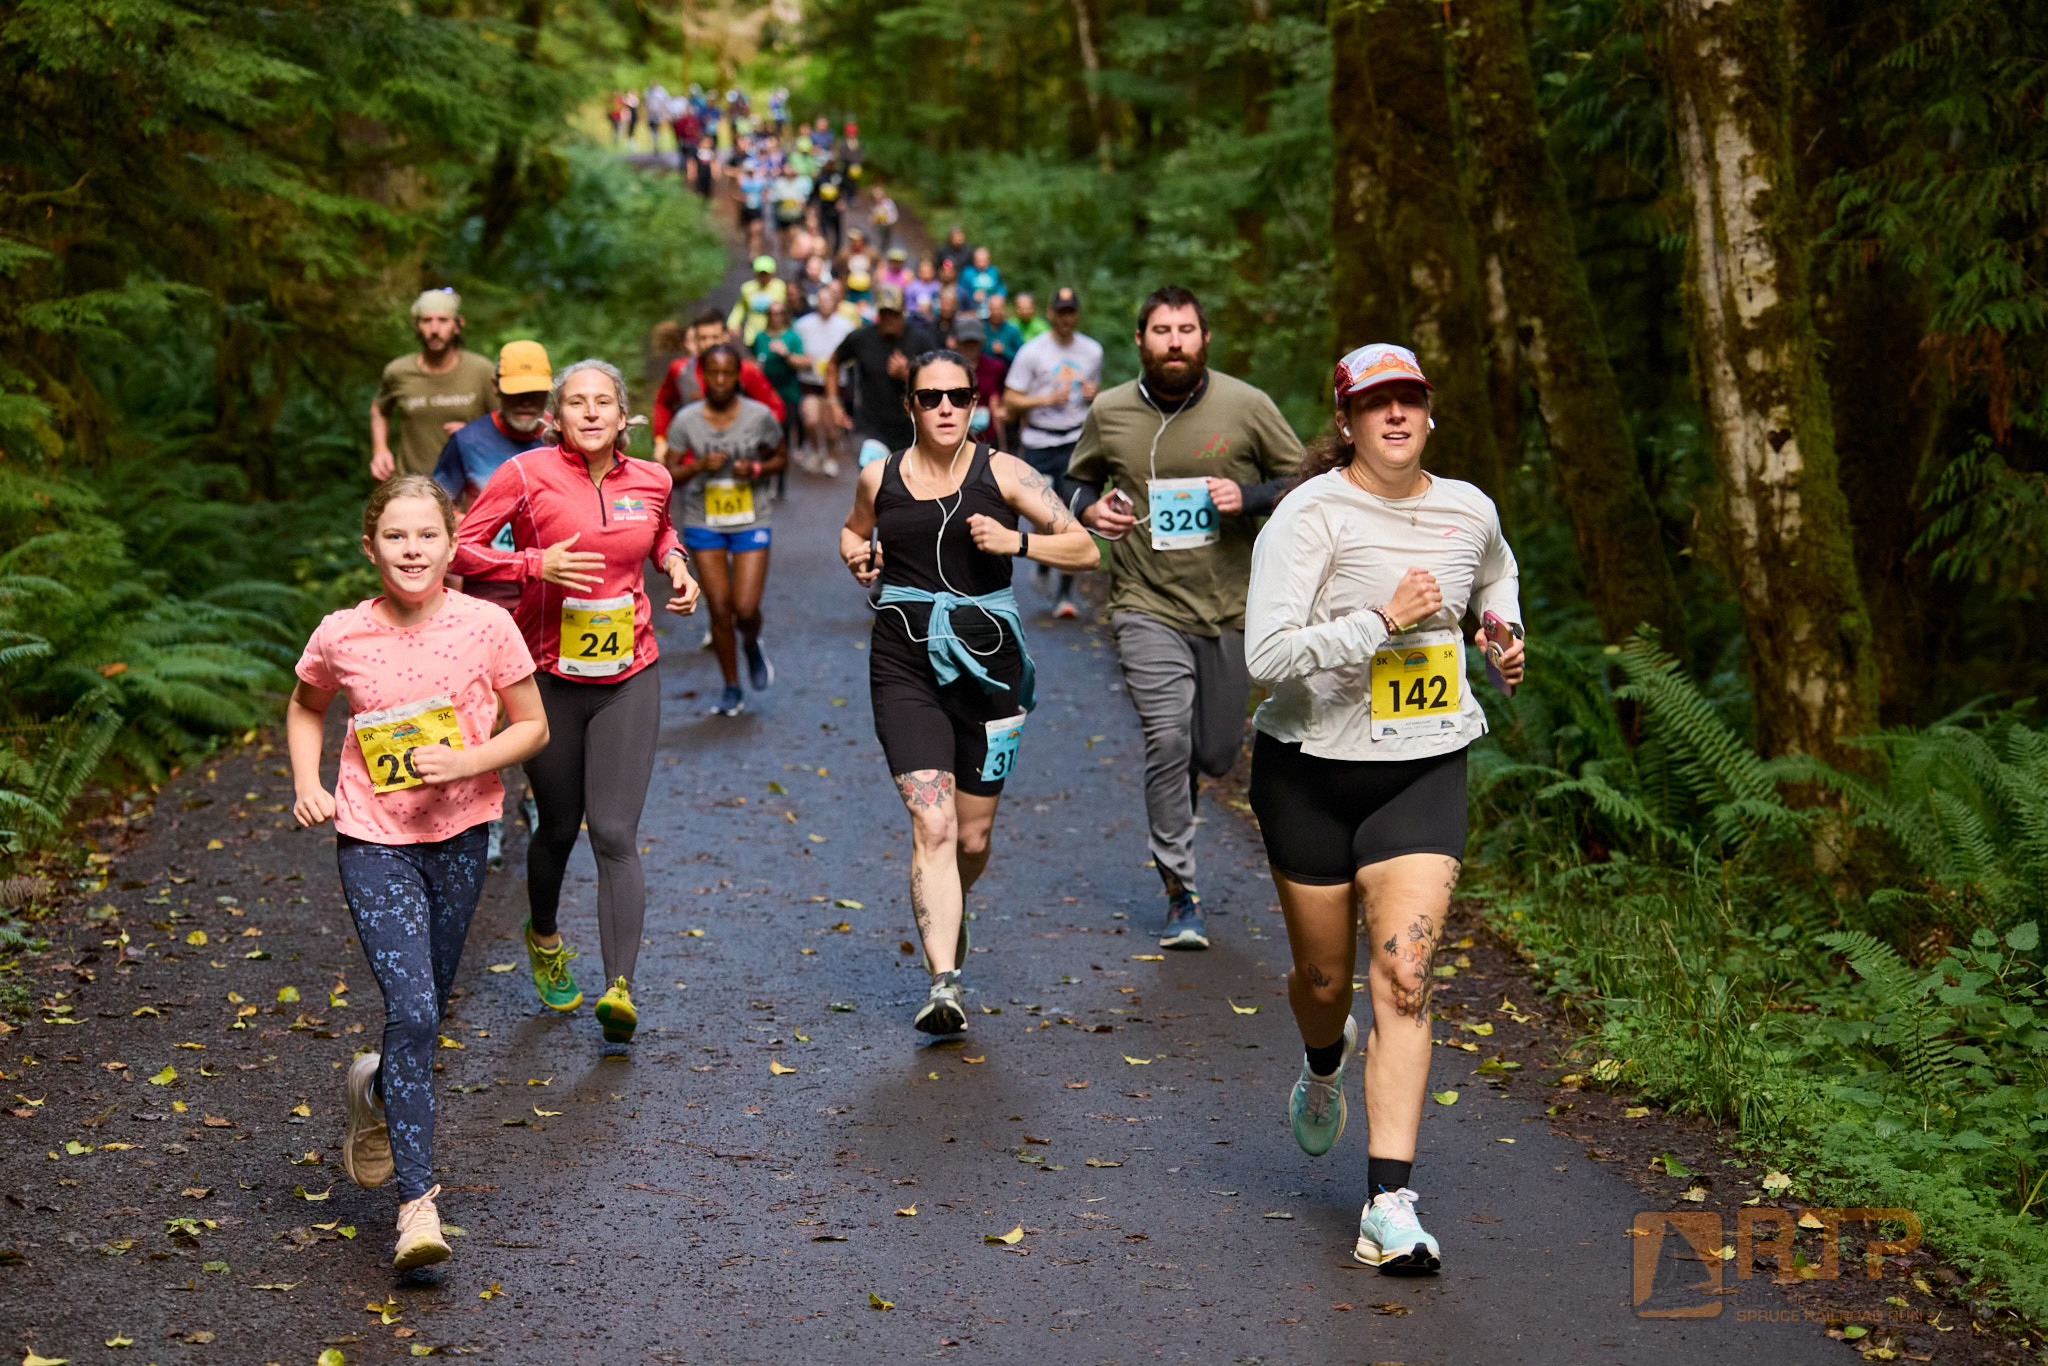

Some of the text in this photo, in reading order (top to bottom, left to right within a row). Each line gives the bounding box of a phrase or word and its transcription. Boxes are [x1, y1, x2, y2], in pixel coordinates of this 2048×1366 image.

[714, 498, 743, 515] 161
[1159, 507, 1213, 532] 320
[579, 631, 620, 657] 24
[1376, 657, 1388, 666] 5K
[1443, 650, 1454, 659] 5K
[1388, 675, 1448, 713] 142
[438, 711, 451, 721] 5K
[363, 733, 375, 742] 5K
[992, 748, 1016, 777] 31
